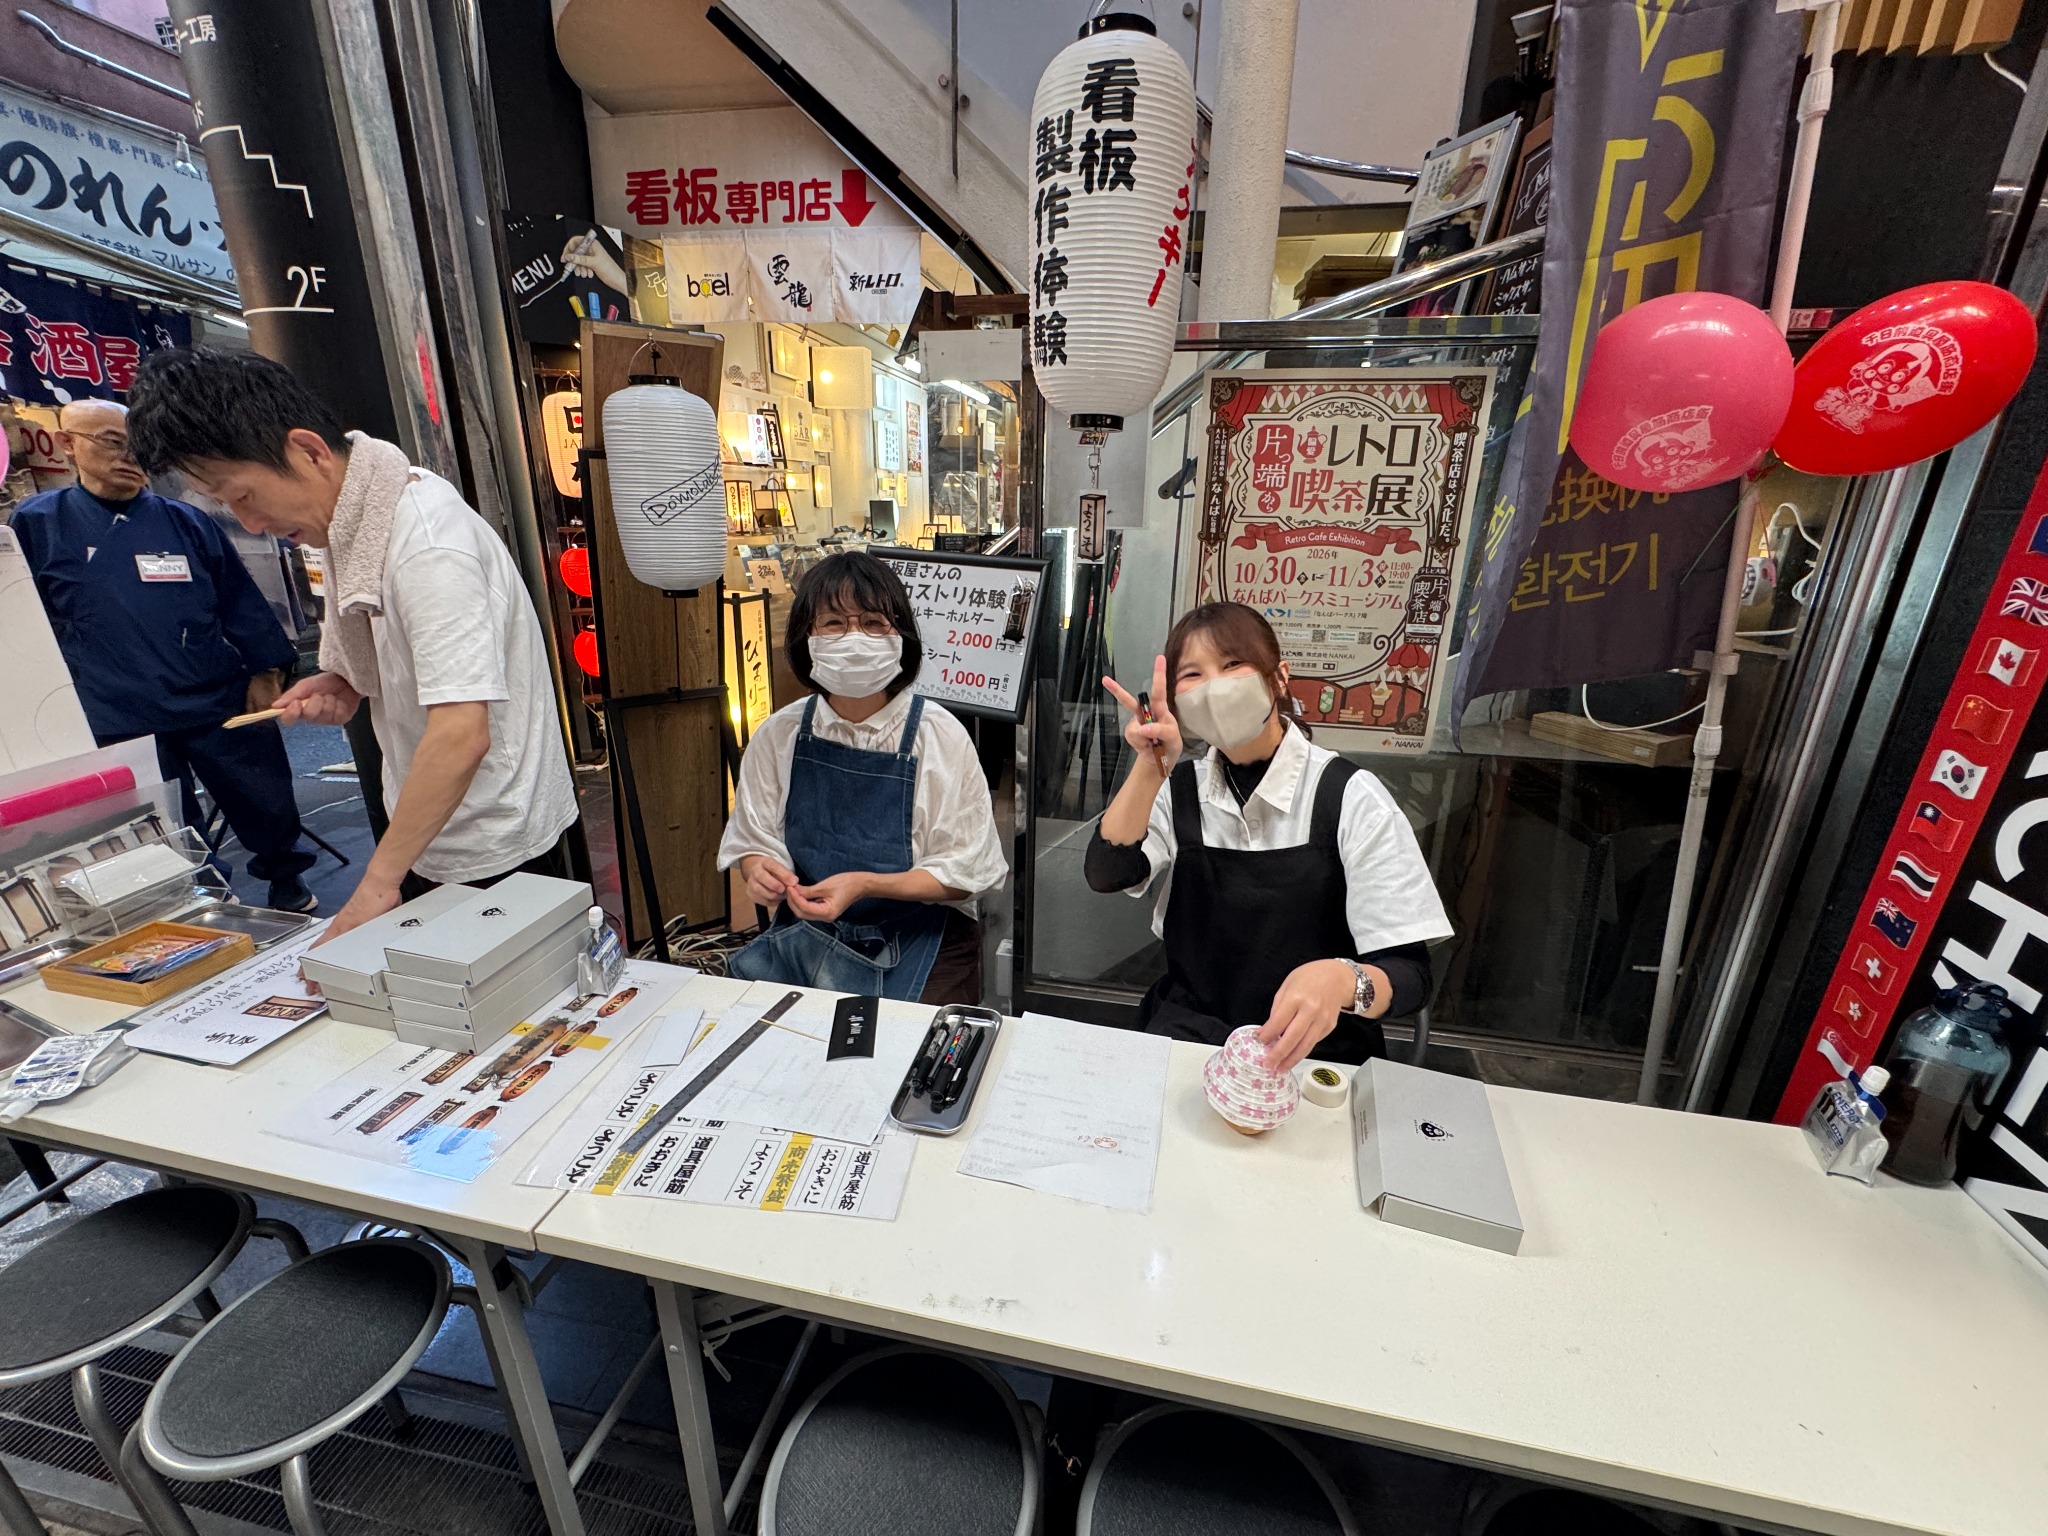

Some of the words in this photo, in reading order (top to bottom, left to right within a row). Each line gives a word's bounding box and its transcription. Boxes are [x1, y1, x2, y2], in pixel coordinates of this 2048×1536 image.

[1078, 57, 1140, 194] 看板
[625, 167, 832, 226] 看板専門店
[1034, 108, 1075, 367] 製作体験
[152, 250, 217, 275] マルサン
[849, 272, 902, 292] 新レトロ
[287, 266, 327, 310] 2F
[0, 313, 140, 393] 酒屋
[1327, 424, 1421, 467] レトロ
[1289, 468, 1415, 518] 喫茶展
[1439, 432, 1467, 543] 喫茶店は、文化だ。
[1081, 503, 1093, 553] ようこそ
[1285, 534, 1307, 545] Retro
[1308, 532, 1328, 542] Cafe
[1329, 532, 1366, 547] Exhibition
[1233, 556, 1297, 585] 10/30
[1328, 558, 1374, 588] 11/3
[1306, 549, 1339, 560] 2026年
[1388, 571, 1409, 579] 19:00
[1232, 588, 1403, 610] なんばパークスミュージアム
[1411, 581, 1430, 624] 喫茶店
[922, 648, 962, 664] シート
[946, 630, 993, 649] 2,000
[941, 668, 986, 688] 1,000
[988, 677, 1000, 690] 円
[616, 1072, 657, 1118] ようこそ
[566, 1128, 615, 1184] ようこそ
[633, 1135, 679, 1187] おおきに
[664, 1136, 713, 1195] 道具屋筋
[734, 1143, 773, 1200] ようこそ
[766, 1145, 808, 1204] 商売繁盛
[803, 1148, 839, 1205] おおきに
[838, 1150, 873, 1211] 道具屋筋
